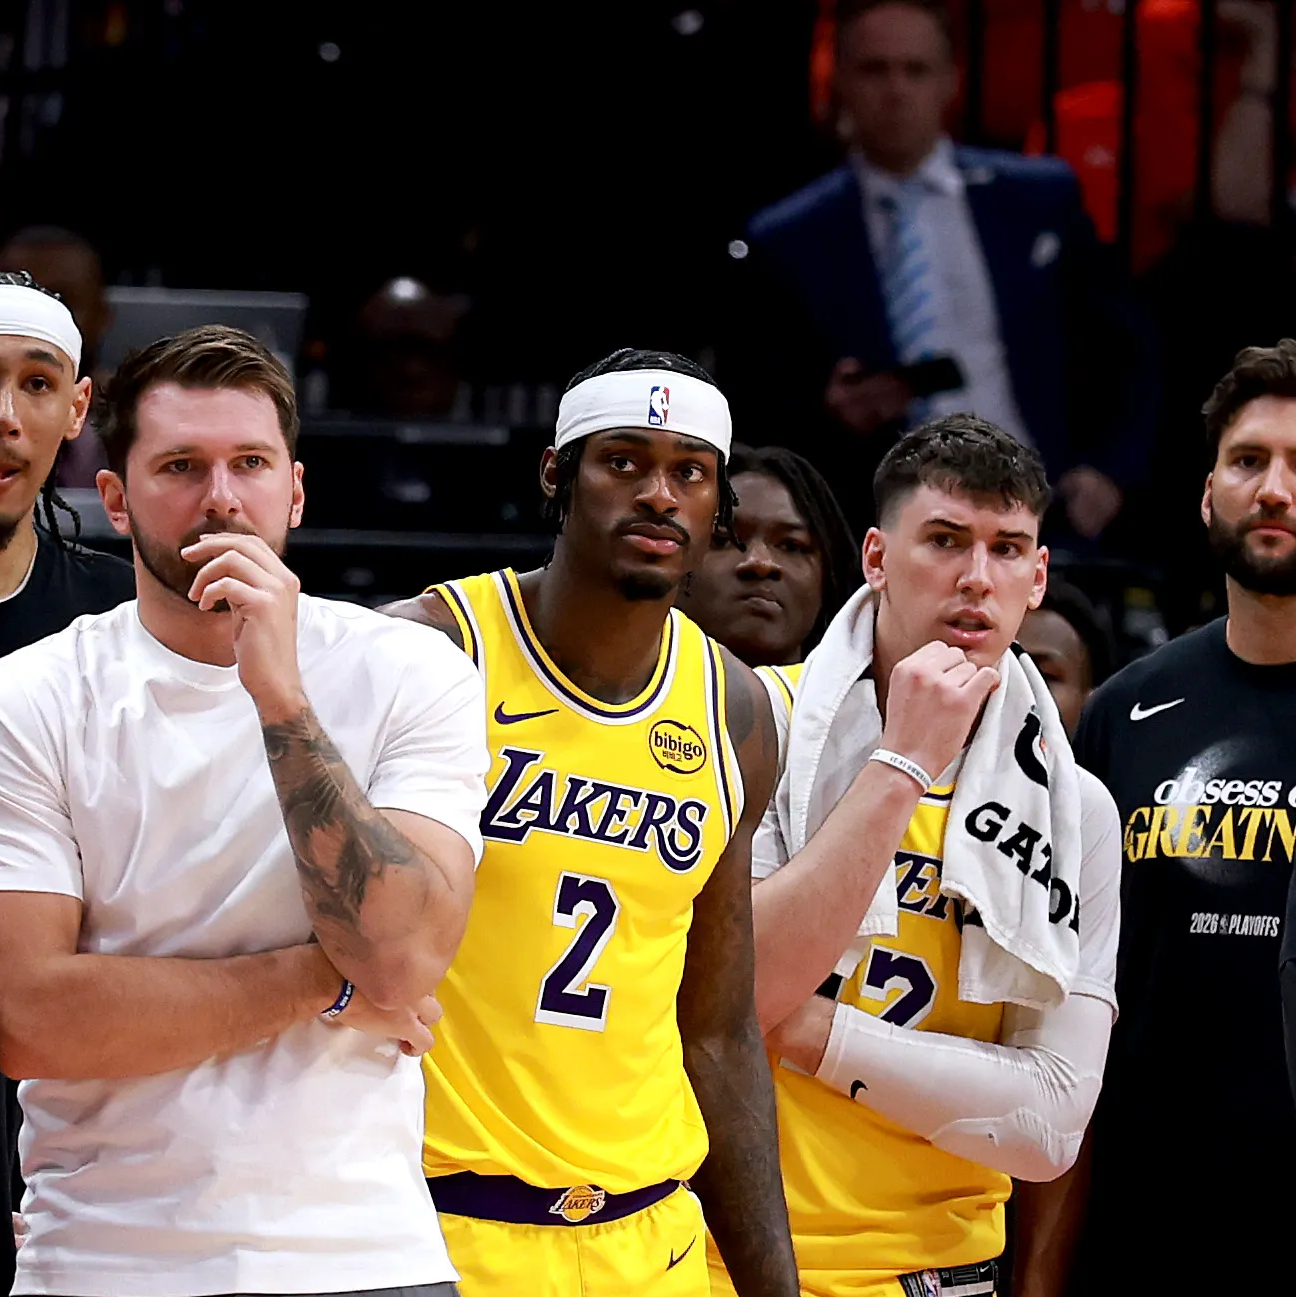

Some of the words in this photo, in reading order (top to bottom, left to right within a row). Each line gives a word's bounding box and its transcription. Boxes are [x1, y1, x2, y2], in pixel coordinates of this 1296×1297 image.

[654, 730, 703, 761] bibigo
[1153, 766, 1283, 807] obsess
[479, 745, 709, 873] LAKERS
[1189, 911, 1220, 935] 2026
[1227, 914, 1280, 938] PLAYOFFS
[535, 871, 620, 1031] 2
